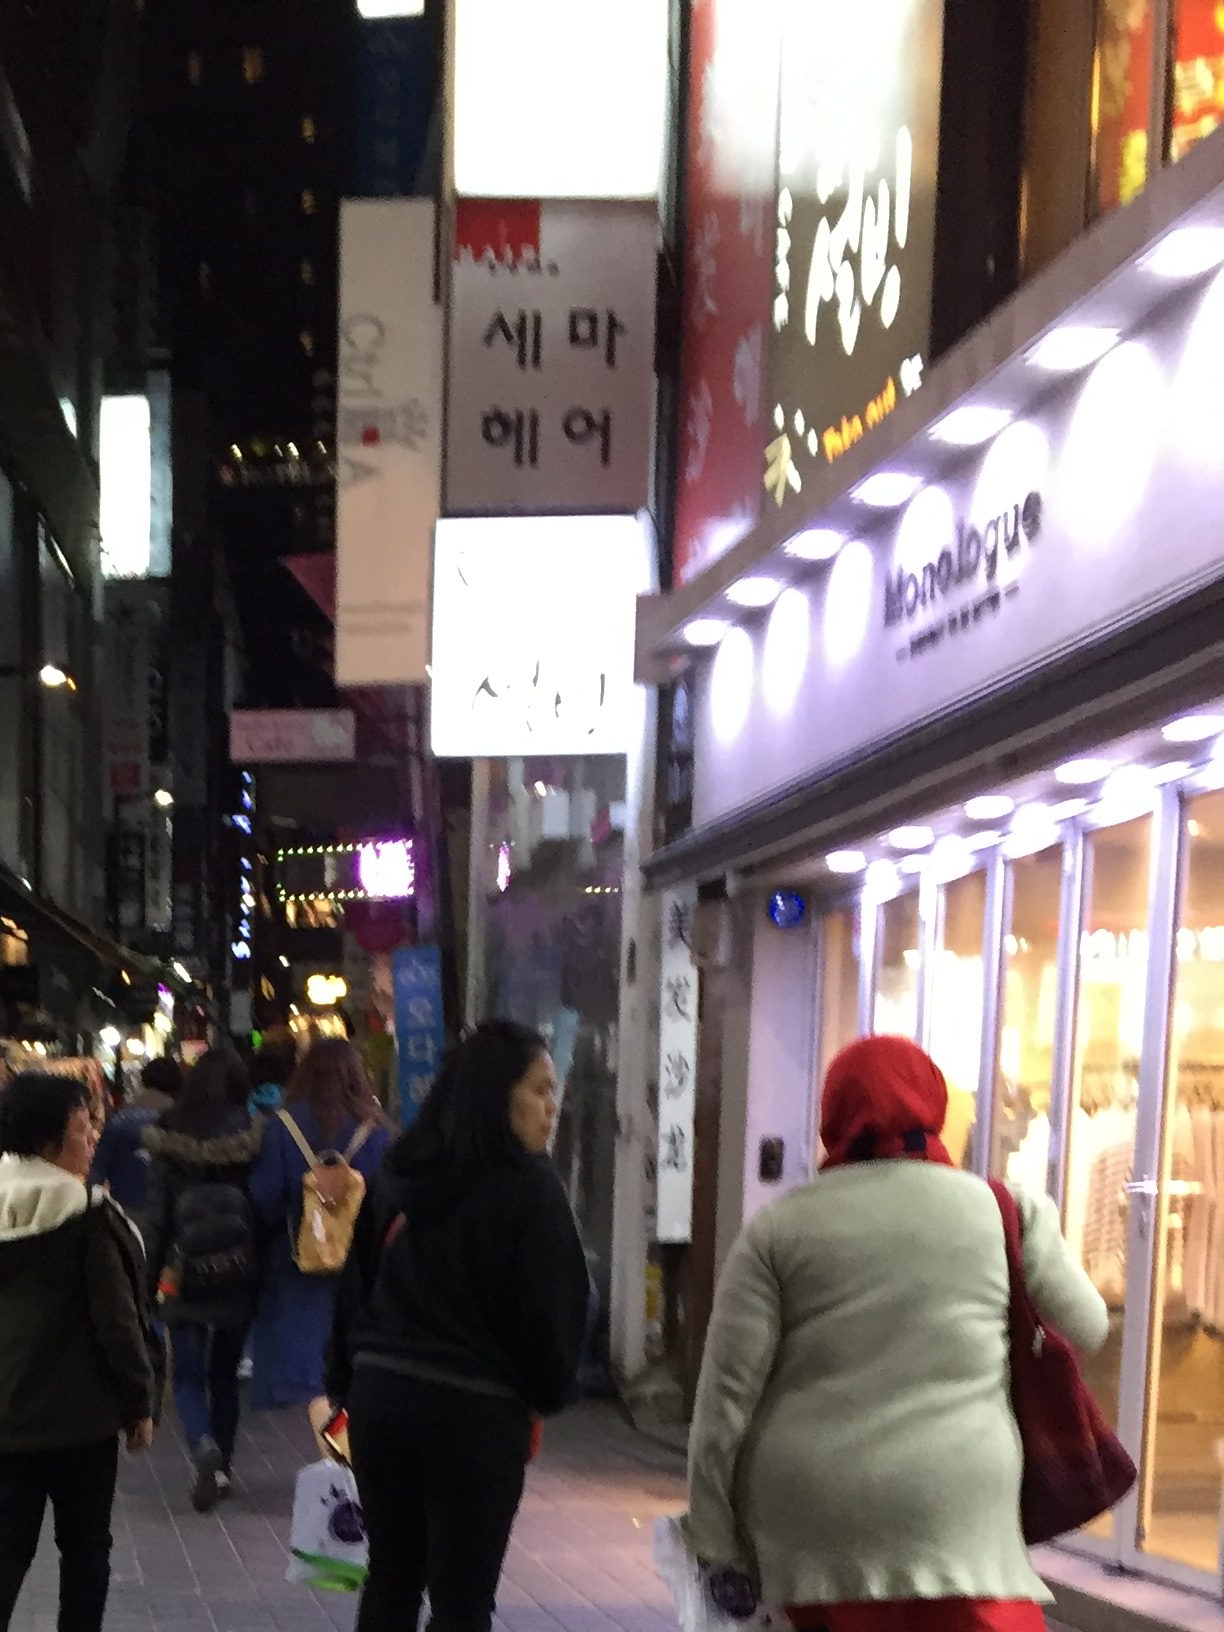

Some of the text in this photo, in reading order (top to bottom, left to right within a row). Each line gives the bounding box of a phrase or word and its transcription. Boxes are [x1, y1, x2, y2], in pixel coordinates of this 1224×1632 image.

[482, 308, 625, 371] 세마
[479, 405, 612, 469] 헤어
[884, 491, 1043, 628] Monologue
